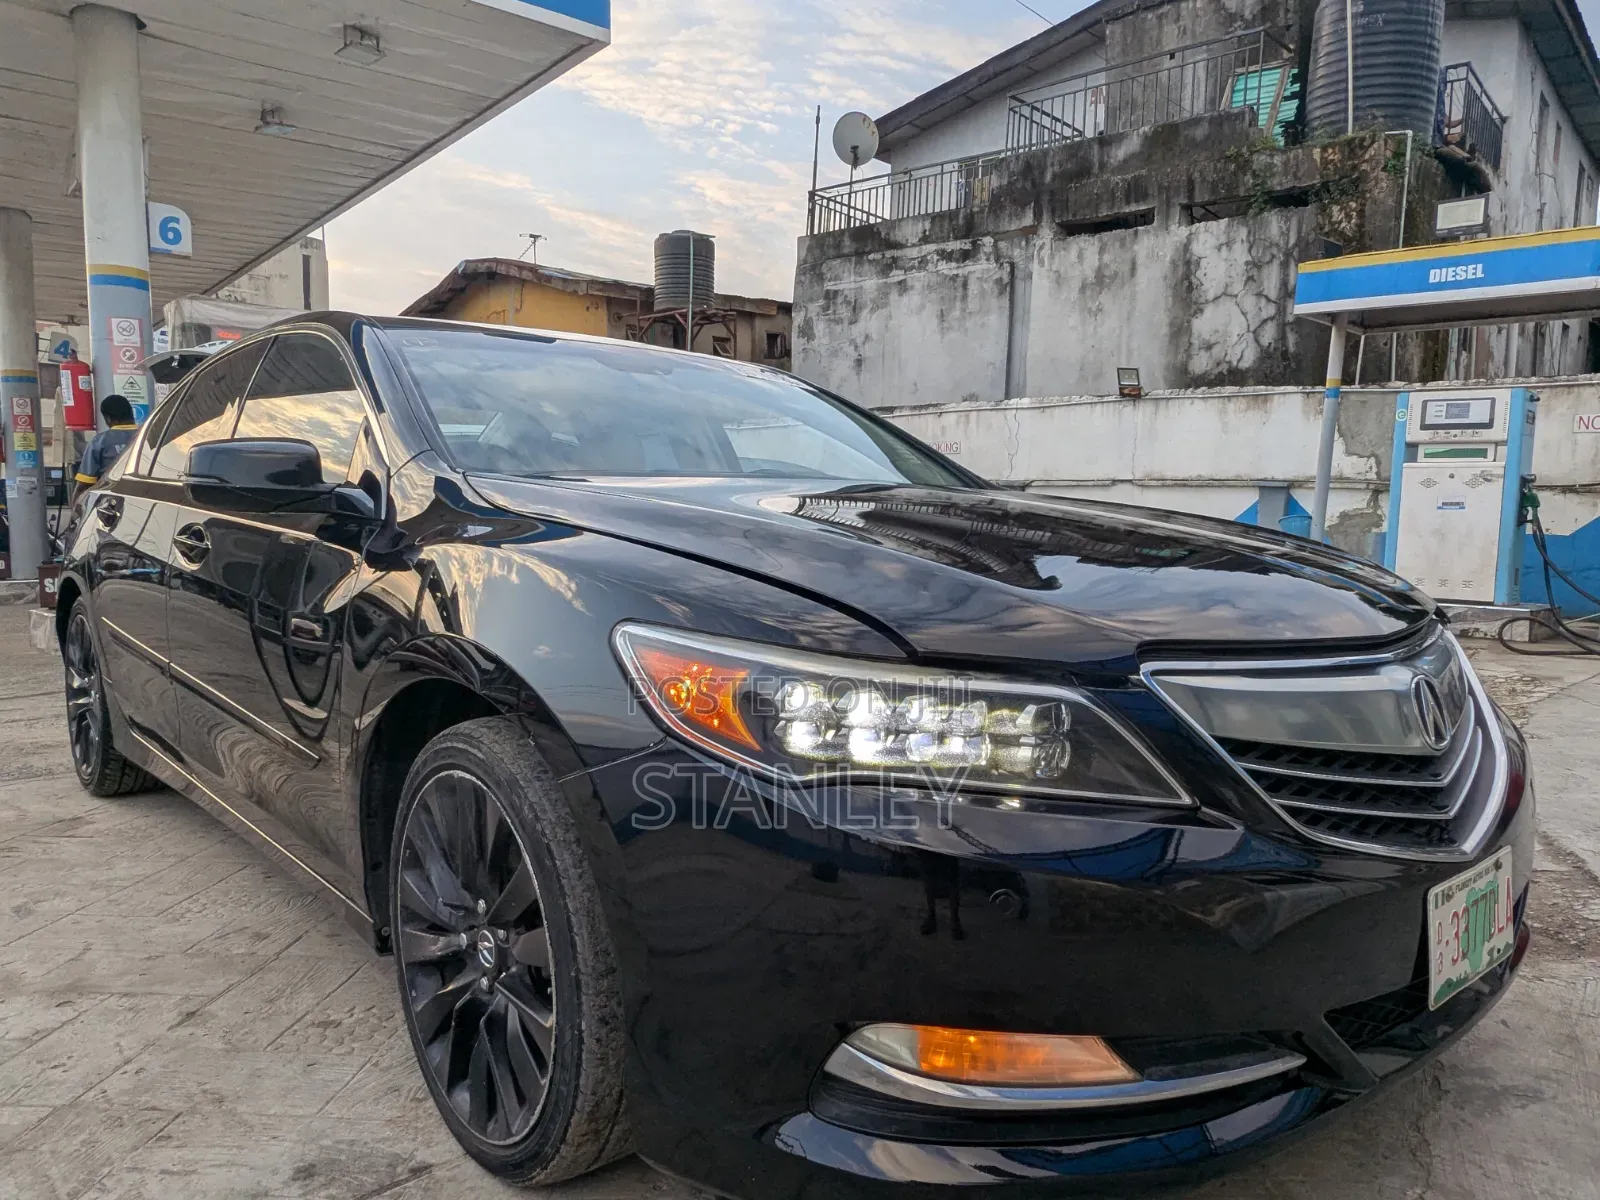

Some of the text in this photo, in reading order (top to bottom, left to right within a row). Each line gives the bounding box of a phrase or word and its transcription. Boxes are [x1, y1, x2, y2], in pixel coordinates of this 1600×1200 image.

[159, 215, 183, 246] 6
[1428, 263, 1485, 284] DIESEL
[54, 340, 70, 359] 4
